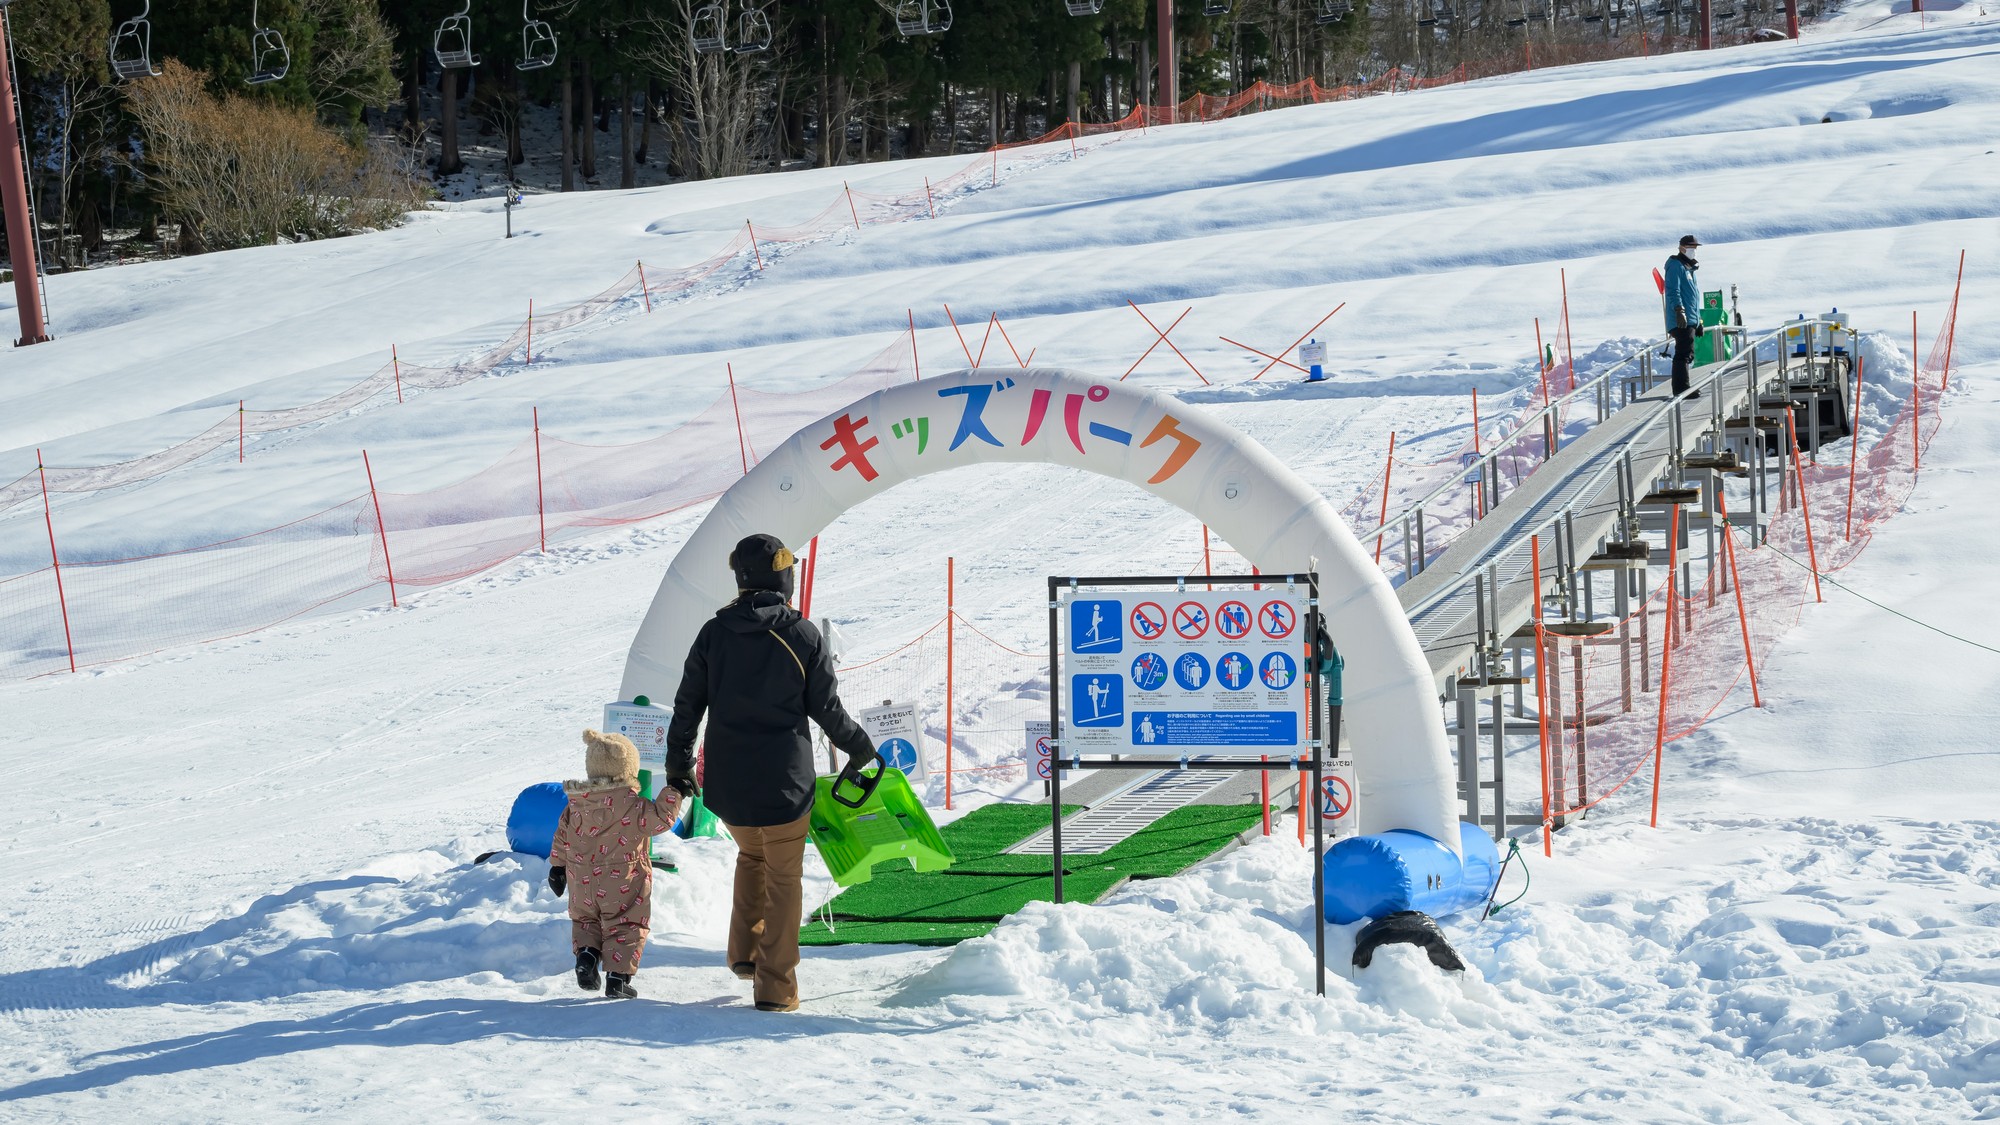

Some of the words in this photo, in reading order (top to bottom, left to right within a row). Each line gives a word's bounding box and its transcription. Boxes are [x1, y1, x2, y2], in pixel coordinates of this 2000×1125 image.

[819, 377, 1202, 485] キッズパーク
[882, 710, 912, 720] まえをむいて
